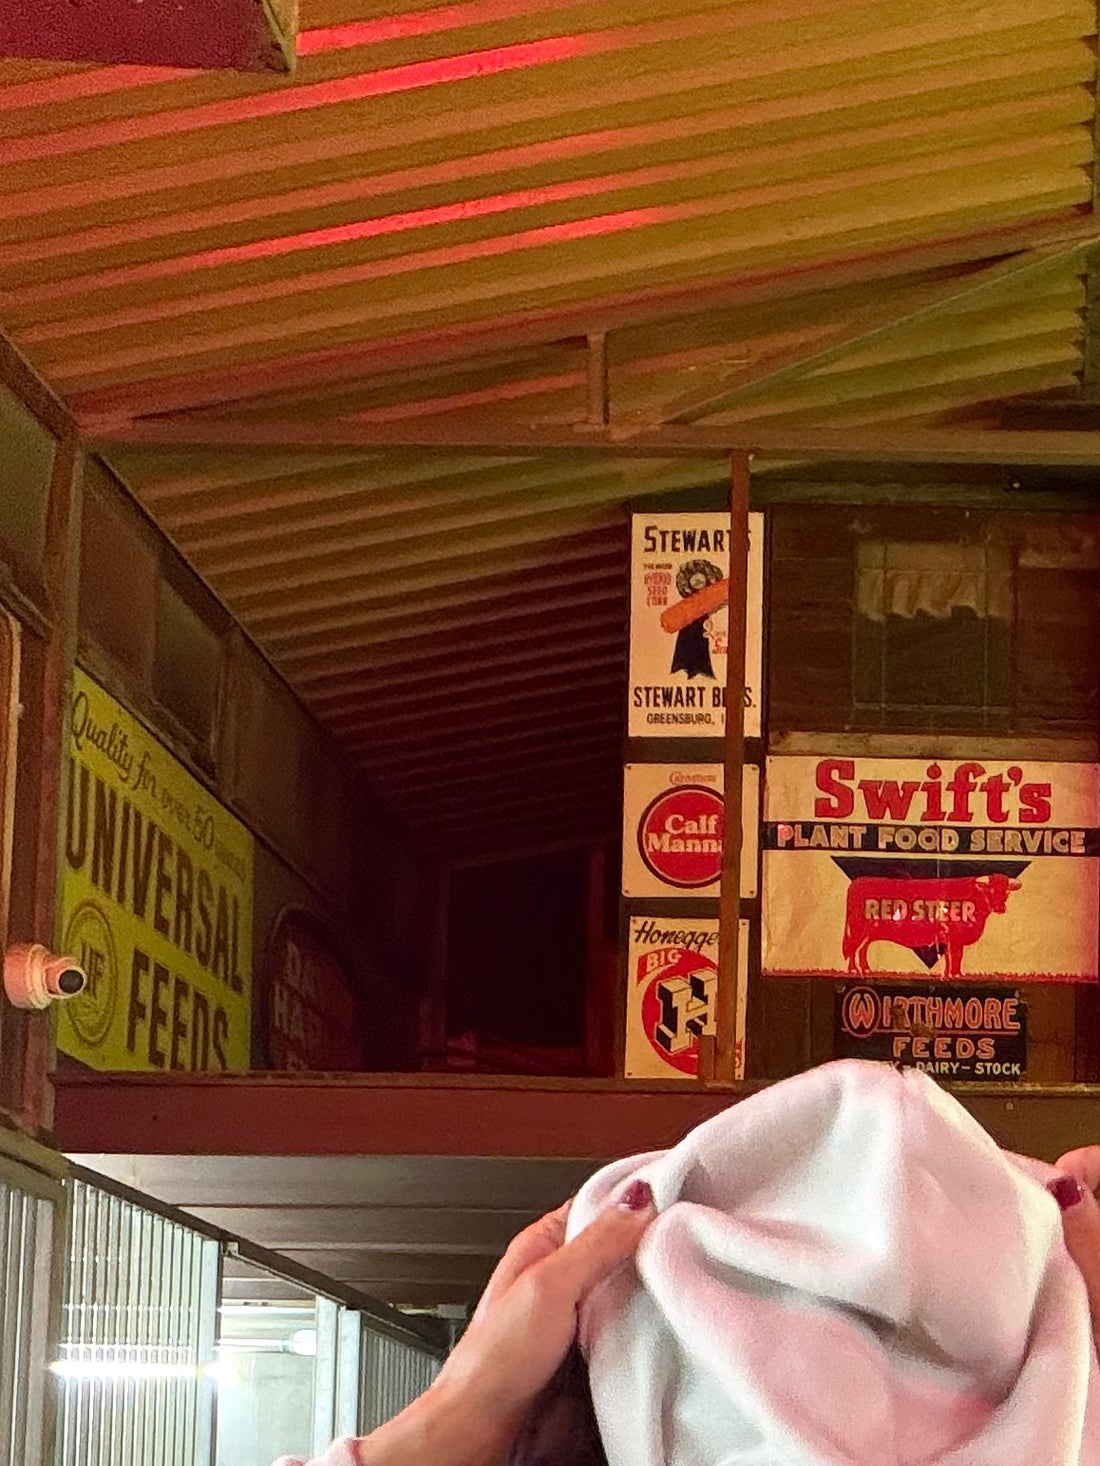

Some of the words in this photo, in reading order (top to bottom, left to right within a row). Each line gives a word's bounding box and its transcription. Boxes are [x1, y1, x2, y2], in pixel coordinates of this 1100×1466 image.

[634, 686, 705, 708] STEWART
[712, 686, 757, 708] BS.
[71, 691, 134, 781] Quality
[132, 751, 158, 798] for
[195, 806, 214, 850] 50
[814, 758, 1052, 824] Swift's
[664, 814, 719, 835] Calf
[777, 824, 866, 849] PLANT
[878, 826, 959, 851] FOOD
[970, 829, 1086, 854] SERVICE
[65, 757, 245, 994] UNIVERSAL
[864, 899, 908, 921] RED
[911, 900, 977, 923] STEER
[634, 920, 719, 953] Honegge
[645, 949, 683, 974] BIG
[126, 946, 230, 1071] FEEDS
[848, 992, 1021, 1030] WIRTHMORE
[892, 1036, 996, 1060] FEEDS
[974, 1062, 1021, 1076] STOCK
